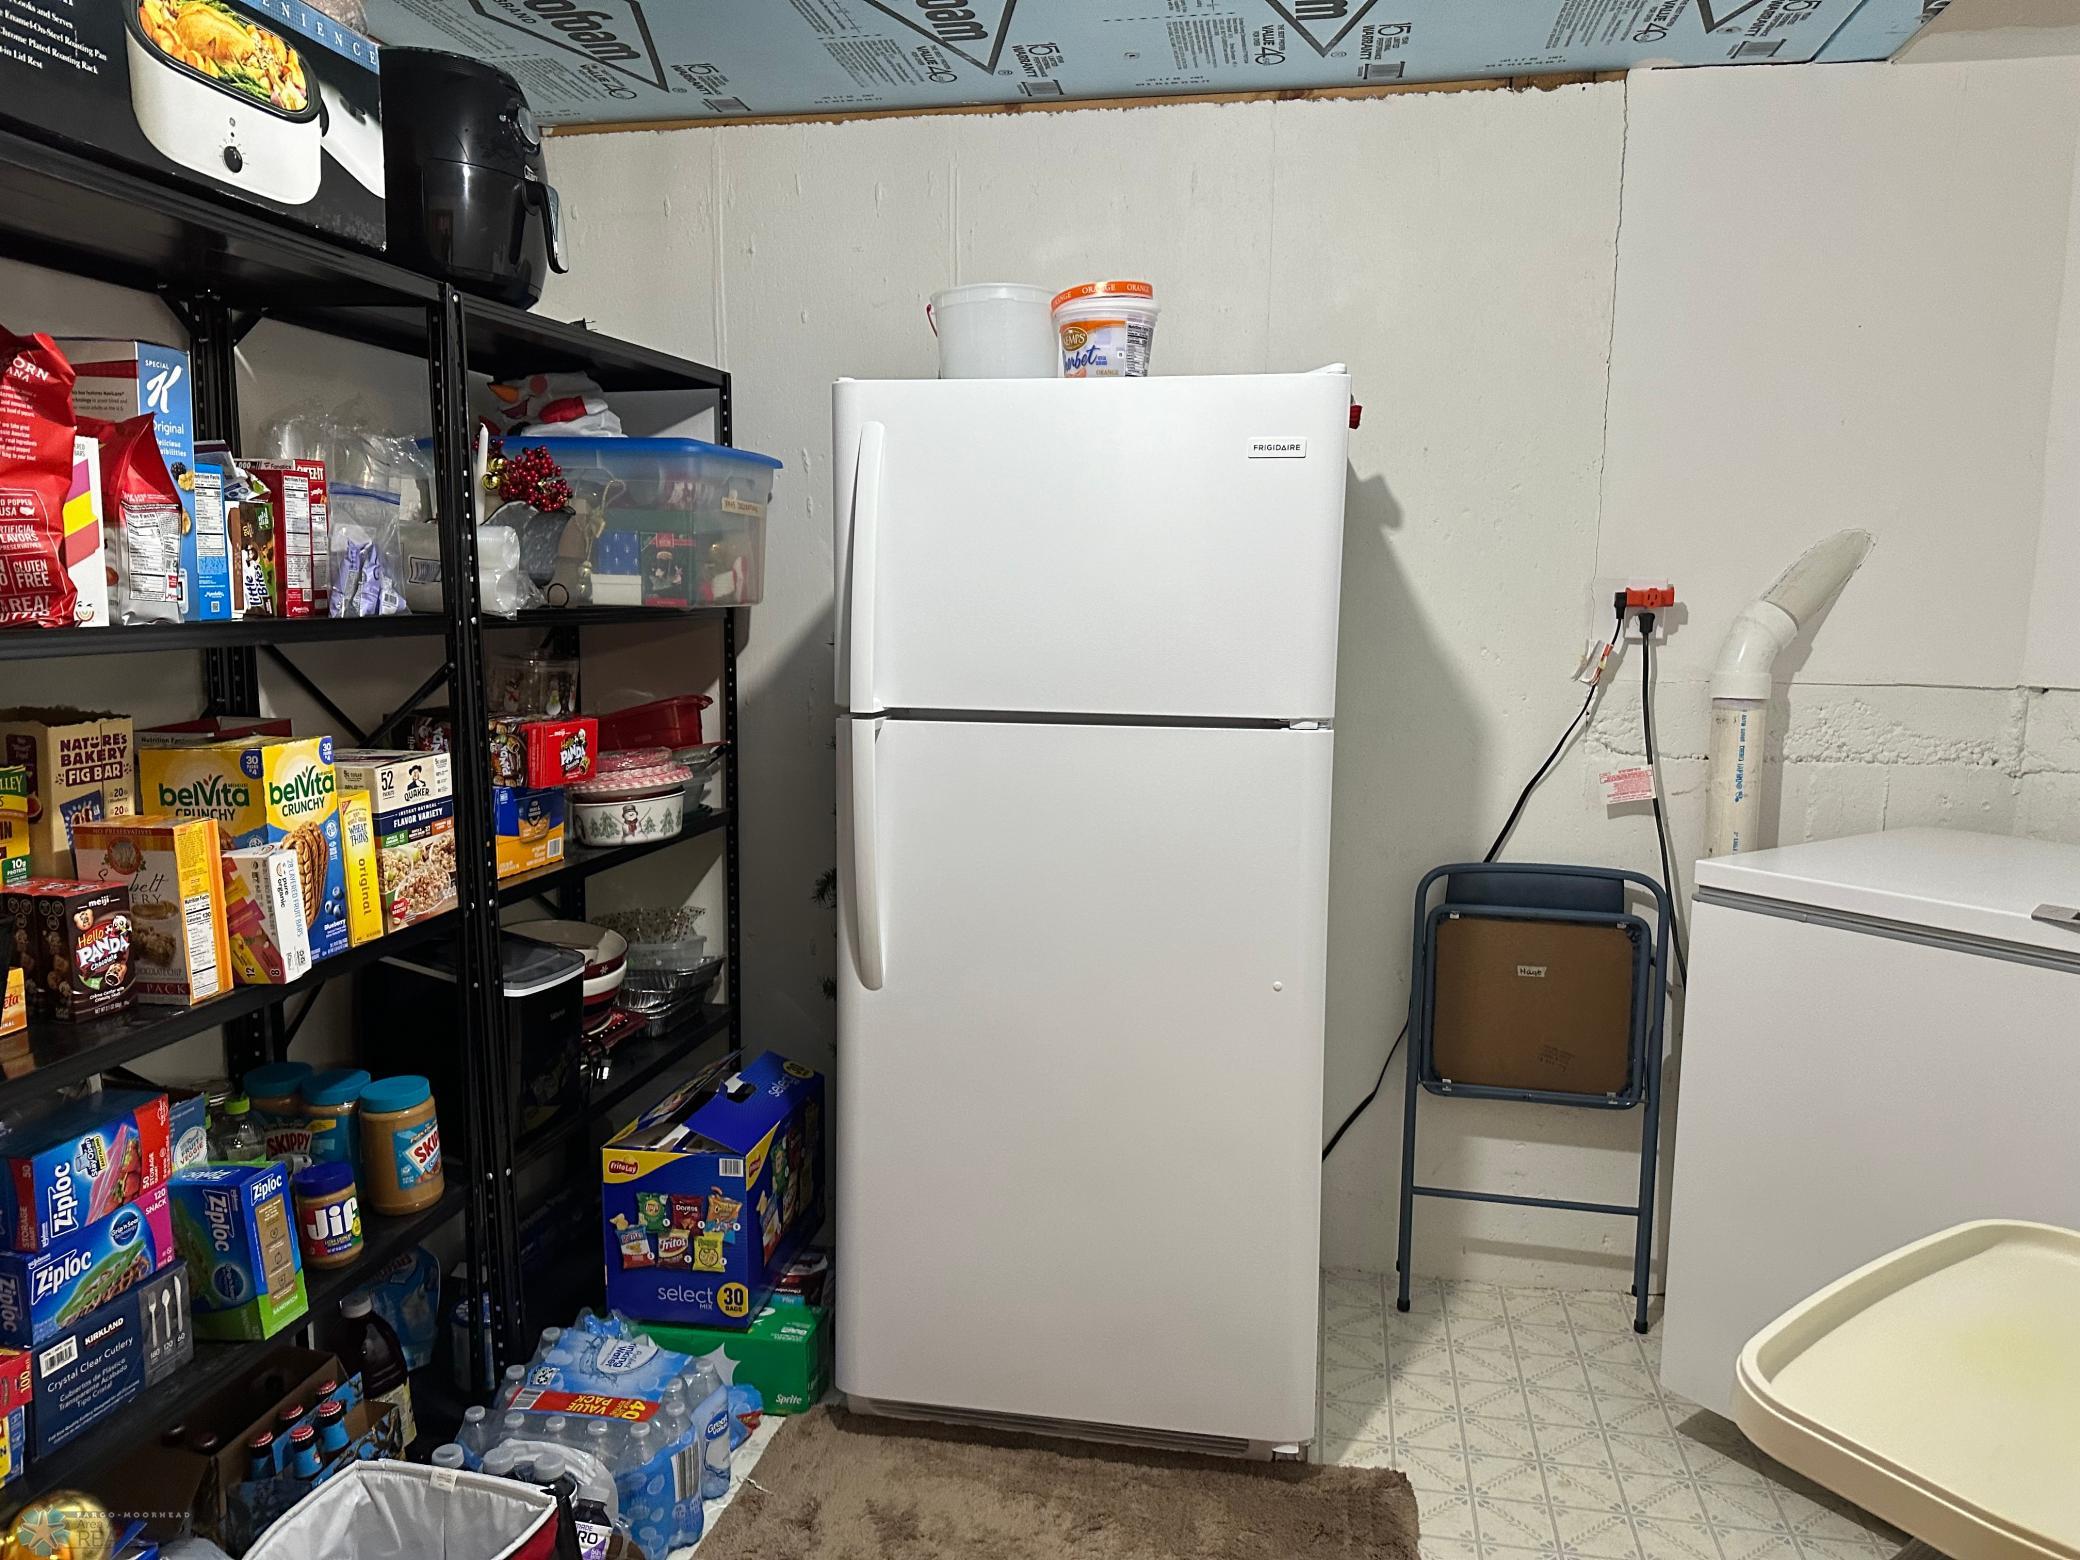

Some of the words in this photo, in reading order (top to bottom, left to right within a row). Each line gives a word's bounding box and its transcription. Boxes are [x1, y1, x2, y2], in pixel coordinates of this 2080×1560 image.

[37, 8, 51, 19] and
[51, 12, 74, 29] Serves
[1261, 24, 1275, 46] VALUE
[1359, 24, 1373, 61] WARRANTY
[28, 38, 51, 55] Plated
[51, 48, 81, 70] Roasting
[81, 60, 99, 75] Rack
[64, 36, 94, 58] Roasting
[94, 48, 108, 61] Pan
[916, 46, 937, 67] VALUE
[1254, 46, 1286, 66] 40
[13, 49, 26, 62] Lid
[27, 55, 43, 70] Rest
[1012, 45, 1038, 78] WARRANTY
[925, 66, 957, 84] 40
[1126, 283, 1150, 293] ORANGE
[145, 359, 170, 370] SPECIAL
[1253, 444, 1301, 452] FRIGIDAIRE
[13, 559, 48, 574] GLUTEN
[16, 570, 51, 588] FREE
[255, 563, 269, 598] Bites
[245, 575, 262, 606] Little
[141, 736, 170, 744] Nutrition
[322, 742, 332, 752] 30
[60, 747, 128, 767] BAKERY
[246, 755, 259, 765] 30
[560, 743, 586, 766] PANDA
[68, 767, 90, 785] FIG
[94, 764, 121, 781] BAR
[381, 770, 395, 791] 52
[114, 788, 124, 798] 20
[158, 774, 250, 807] belVita
[268, 765, 335, 806] belVita
[404, 787, 430, 802] QUAKER
[114, 805, 125, 816] 20
[282, 796, 325, 817] CRUNCHY
[398, 807, 417, 817] INSTANT
[417, 802, 437, 812] OATMEAL
[393, 815, 417, 829] FLAVOR
[418, 807, 443, 822] VARIETY
[349, 822, 368, 835] WHEAT
[350, 830, 369, 847] THINS
[12, 858, 27, 870] 10g
[276, 878, 287, 909] organic
[281, 877, 290, 896] pure
[288, 868, 299, 899] LAYERED
[359, 857, 372, 917] original
[88, 895, 110, 908] meiji
[184, 896, 200, 905] Nutrition
[200, 894, 210, 902] Facts
[323, 919, 346, 931] Blueberry
[77, 928, 104, 949] Hello
[76, 934, 130, 967] PANDA
[91, 952, 118, 971] Chocolate
[246, 967, 256, 978] 12
[271, 969, 280, 977] 8
[146, 983, 186, 995] PACK
[267, 1132, 311, 1154] SKIPPY
[180, 1142, 204, 1165] VEGGIE
[22, 1165, 31, 1178] 50
[143, 1175, 150, 1190] 50
[252, 1175, 283, 1200] Ziploc
[53, 1162, 78, 1234] Ziploc
[153, 1188, 166, 1199] 120
[145, 1198, 167, 1216] SNACK
[675, 1204, 698, 1212] Doritos
[205, 1195, 230, 1252] Ziploc
[307, 1197, 358, 1241] Jif
[661, 1238, 687, 1250] Fritos
[36, 1251, 92, 1295] Ziploc
[0, 1277, 17, 1333] Ziploc
[657, 1284, 713, 1305] select
[723, 1287, 744, 1306] 30
[699, 1303, 713, 1311] MIX
[725, 1305, 743, 1313] BAGS
[84, 1317, 124, 1345] KIRKLAND
[177, 1332, 186, 1343] 60
[162, 1339, 174, 1350] 120
[47, 1368, 79, 1393] Crystal
[80, 1353, 103, 1374] Clear
[104, 1336, 134, 1359] Cutlery
[605, 1346, 627, 1367] Water
[20, 1370, 30, 1393] 100
[59, 1382, 100, 1410] Transparente
[100, 1364, 128, 1385] Acabado
[60, 1379, 92, 1402] Cubiertos
[92, 1373, 101, 1382] de
[77, 1395, 92, 1408] Tipo
[92, 1380, 113, 1397] Cristal
[576, 1394, 613, 1405] PACK
[776, 1393, 802, 1405] Sprite
[567, 1402, 607, 1415] VALUE
[622, 1400, 646, 1420] 40
[707, 1413, 728, 1433] Great
[712, 1422, 728, 1435] Value
